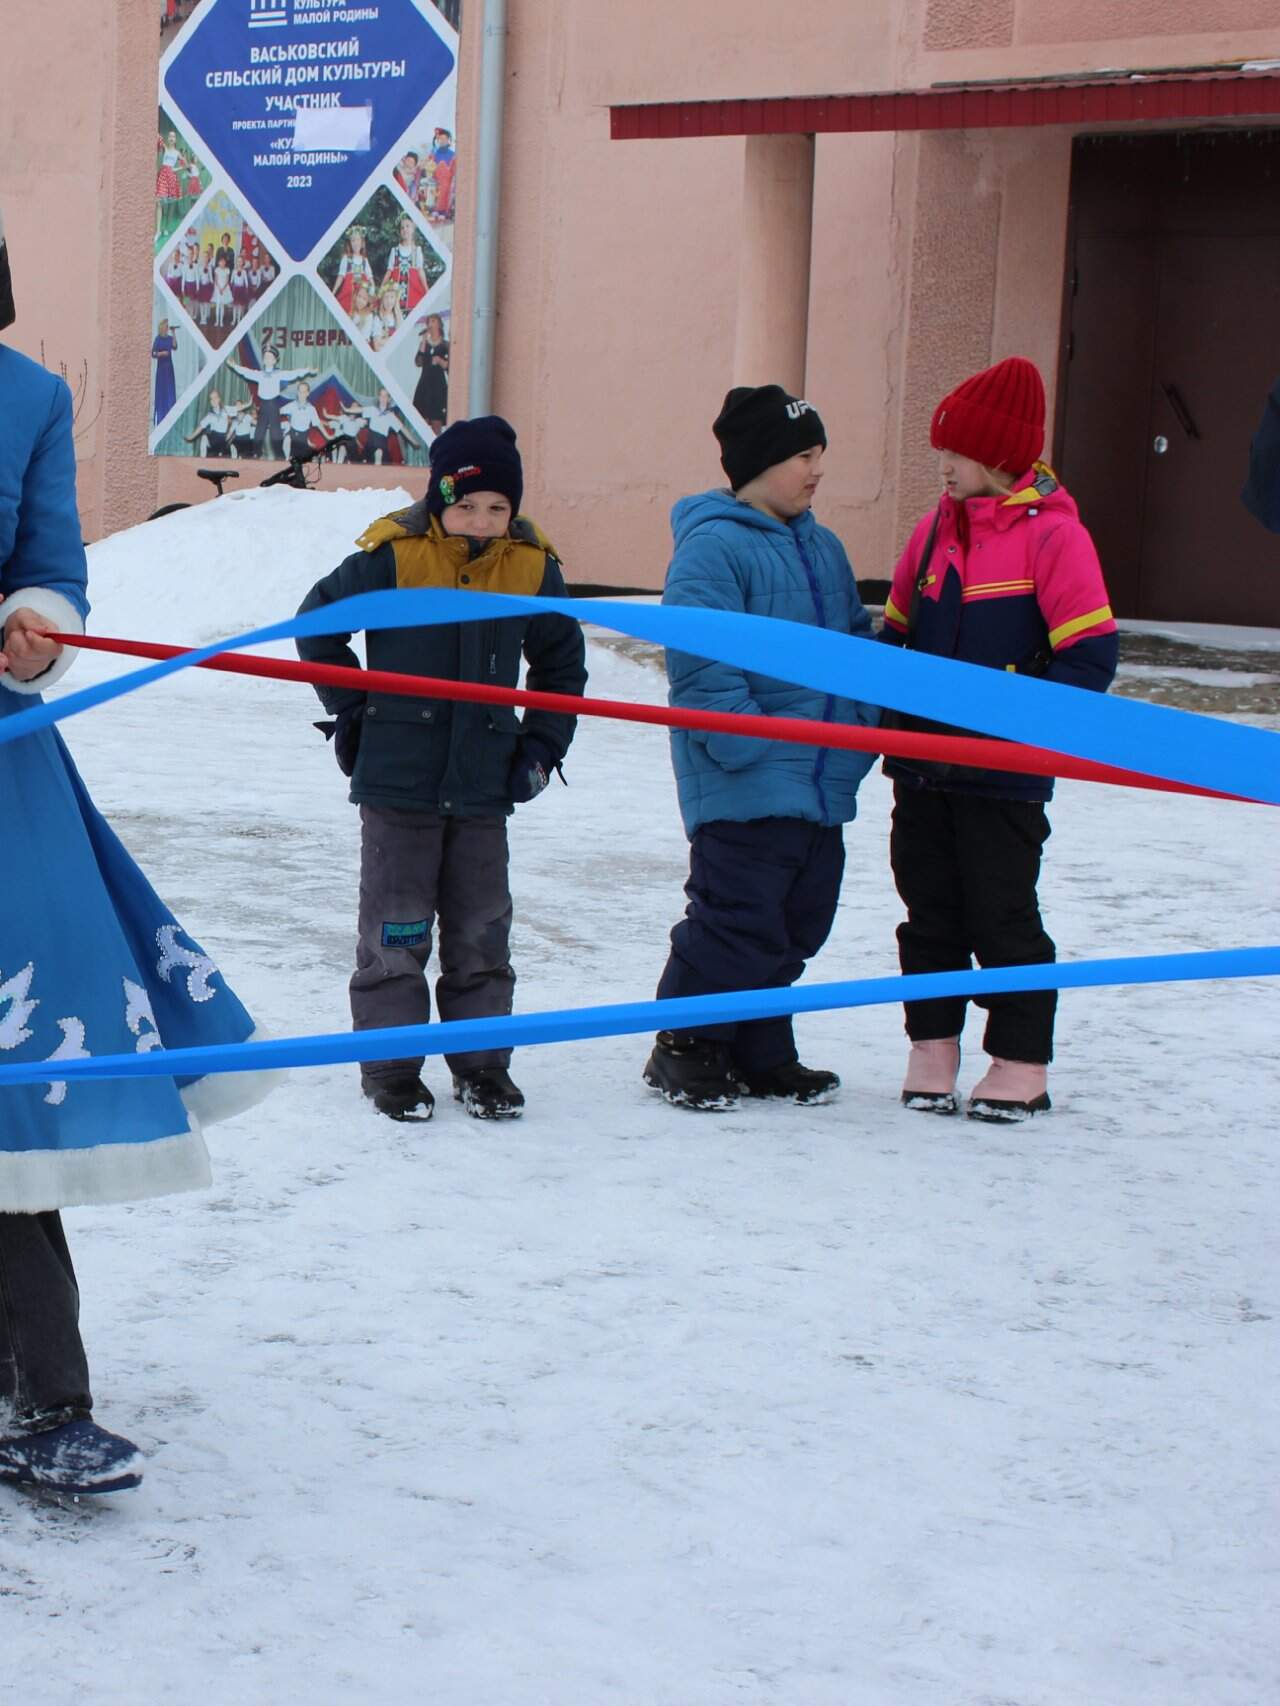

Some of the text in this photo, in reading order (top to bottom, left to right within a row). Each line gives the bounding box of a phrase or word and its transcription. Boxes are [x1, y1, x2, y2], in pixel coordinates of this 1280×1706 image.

[293, 7, 379, 25] МАЛОЙ РОДИНЫ
[250, 36, 359, 64] ВАСЬКОВСКИЙ
[205, 60, 406, 88] СЕЛЬСКИЙ ДОМ КУЛЬТУРЫ
[264, 92, 341, 112] УЧАСТНИК
[232, 120, 266, 130] ПРОЕКТА
[253, 152, 348, 167] МАЛОЙ РОДИНЫ»
[286, 176, 312, 188] 2023
[261, 327, 353, 348] 23 ФЕВРА
